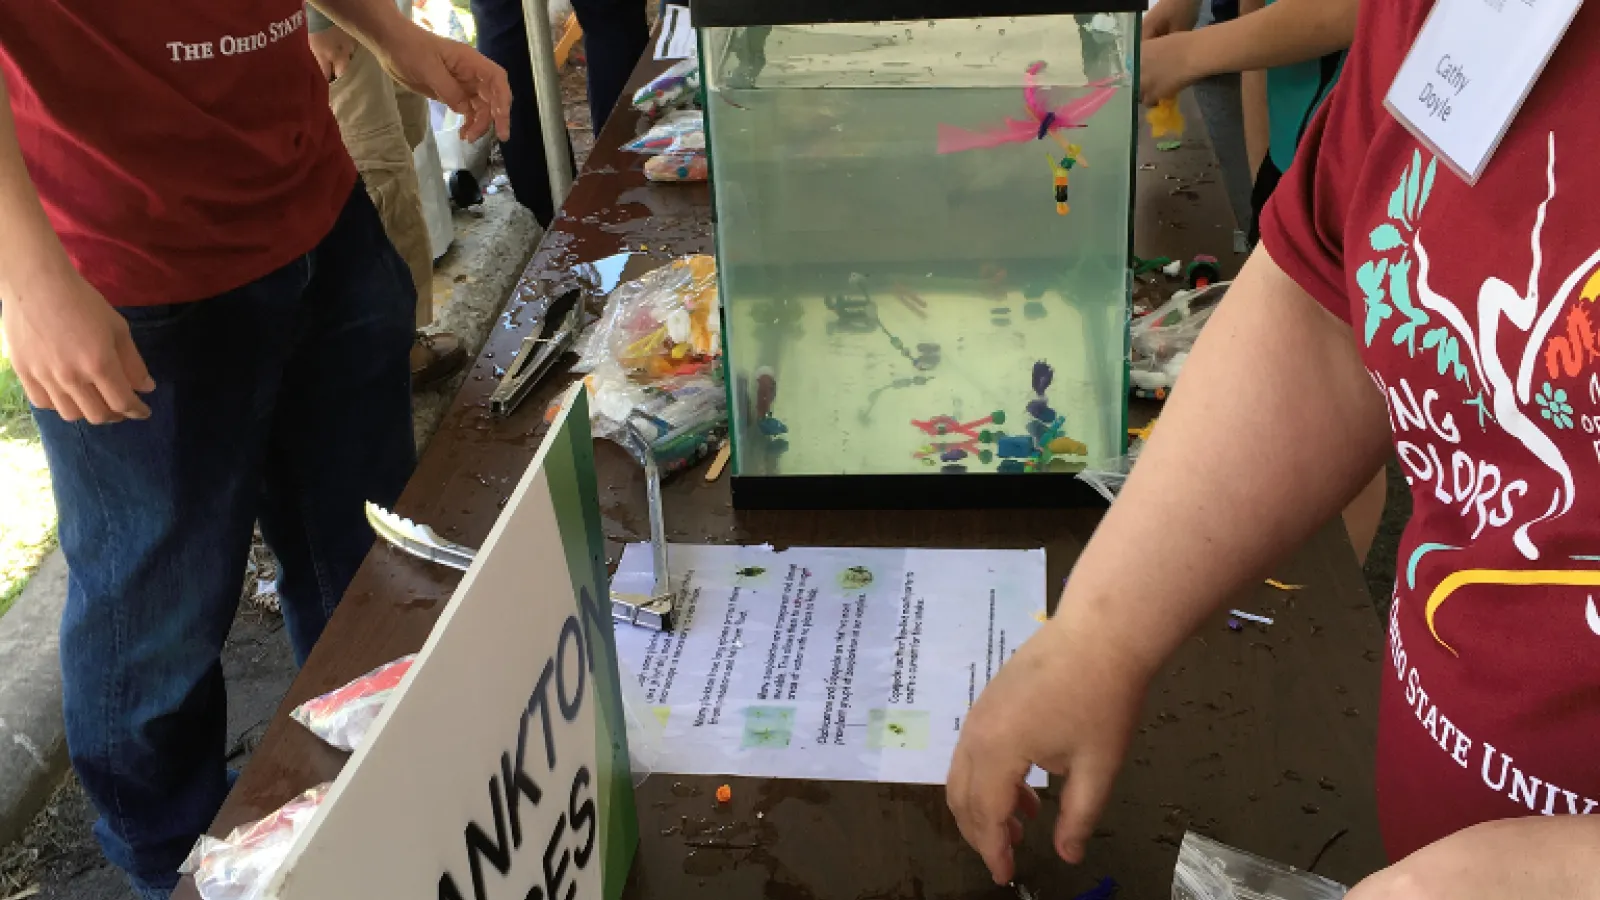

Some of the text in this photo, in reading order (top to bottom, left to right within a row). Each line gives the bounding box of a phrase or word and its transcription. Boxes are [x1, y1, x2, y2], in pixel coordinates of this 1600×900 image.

[166, 41, 214, 61] THE
[220, 35, 267, 55] OHIO
[1436, 53, 1471, 96] Cathy
[1419, 82, 1452, 121] Doyle
[1397, 441, 1528, 539] OLORS
[1407, 667, 1472, 768] STATE
[524, 766, 596, 900] ES
